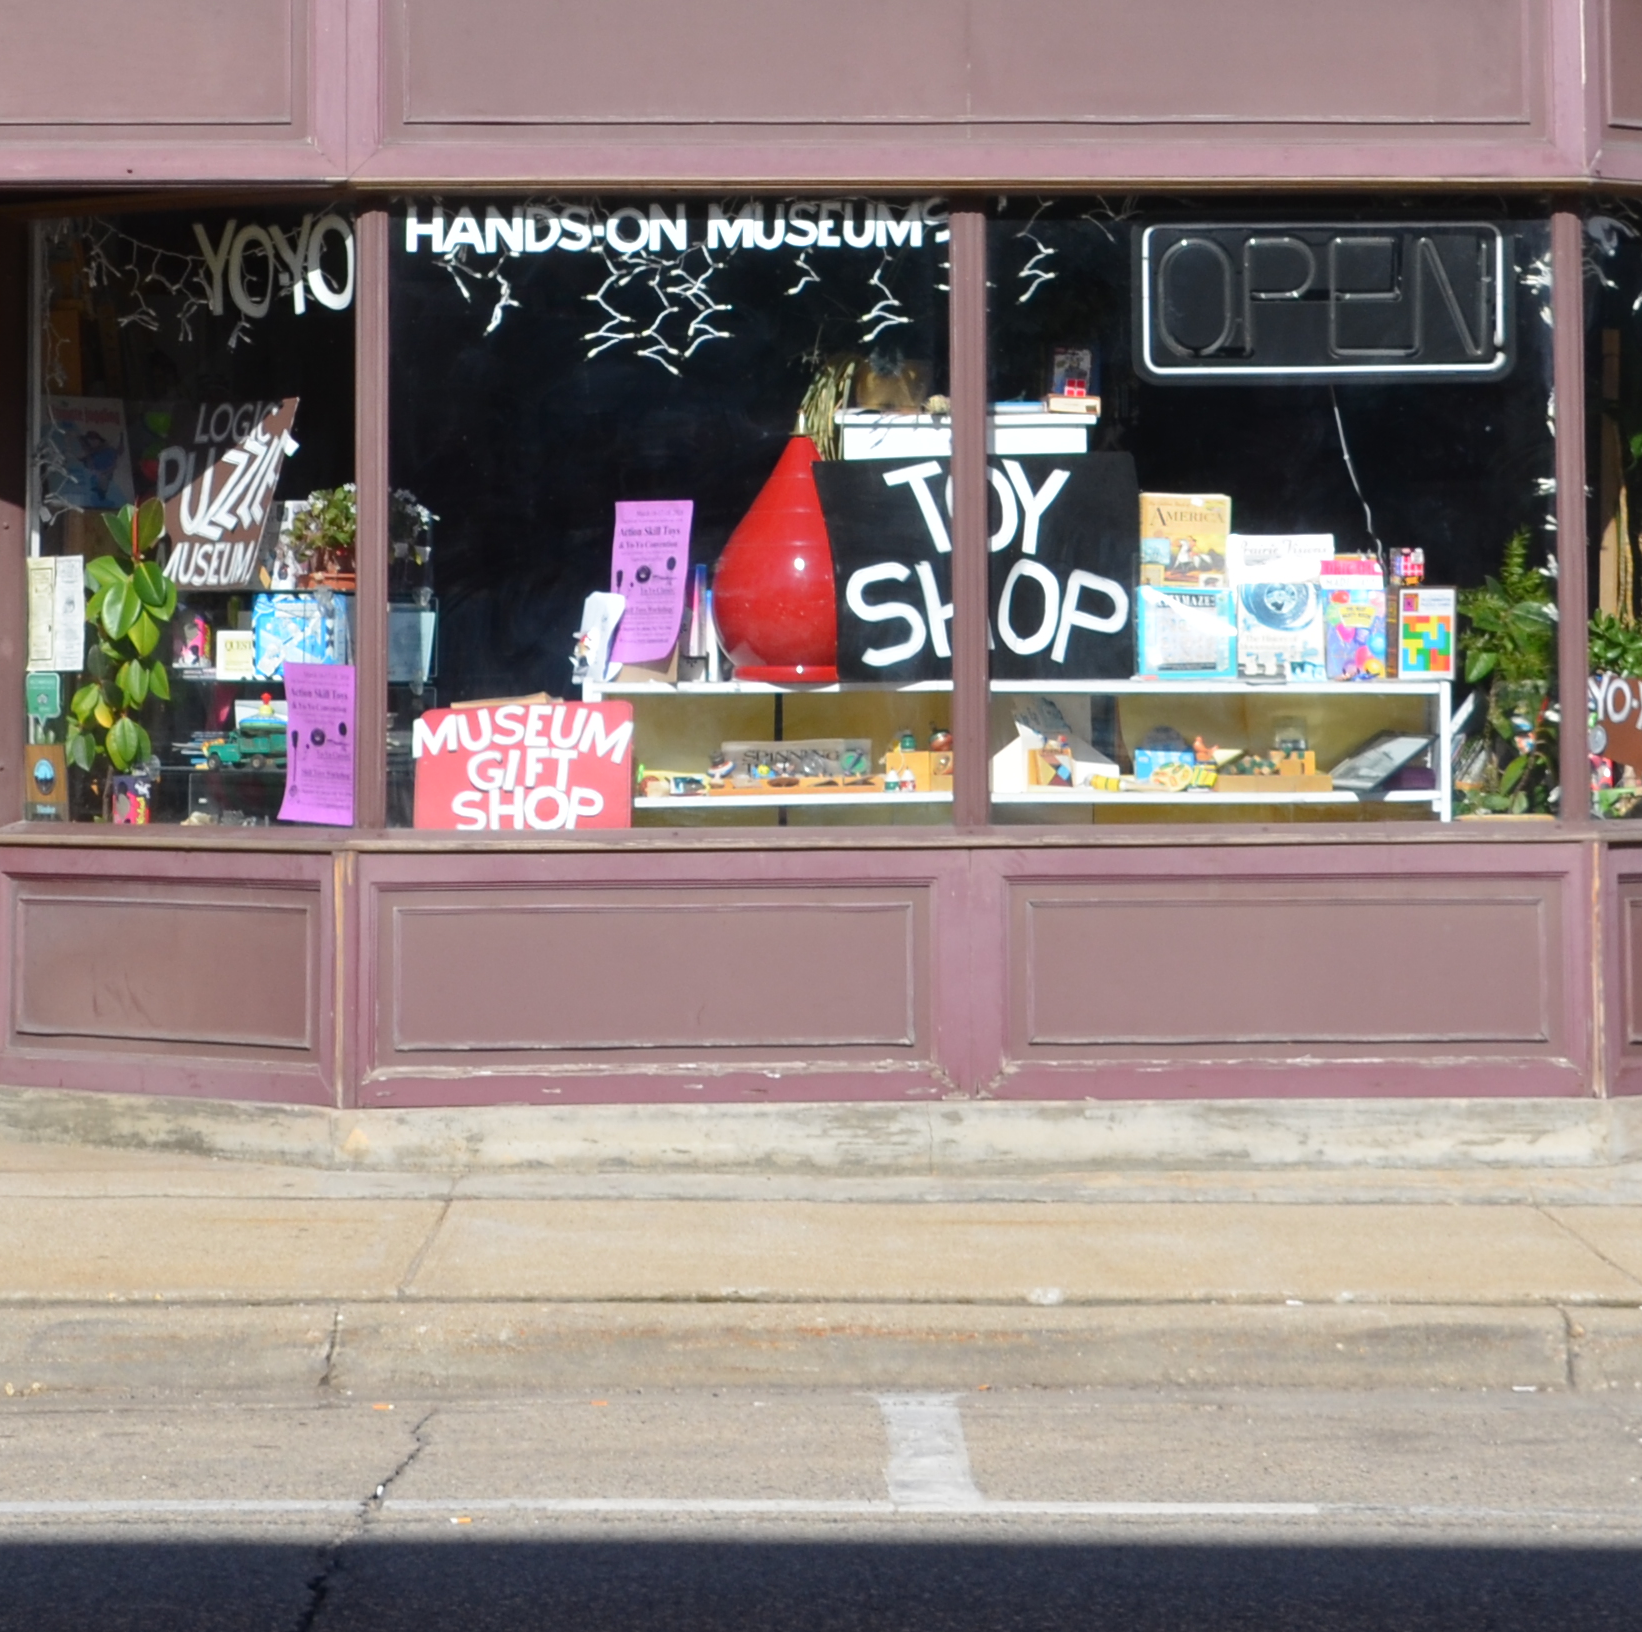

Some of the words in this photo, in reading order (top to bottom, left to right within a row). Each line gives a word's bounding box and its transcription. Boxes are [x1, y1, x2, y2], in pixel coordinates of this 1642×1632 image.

[406, 204, 688, 253] HANDS-ON
[1157, 236, 1488, 359] OPEN
[194, 401, 276, 446] LOGIC
[644, 526, 661, 536] Skill
[663, 525, 680, 538] Toys
[1150, 507, 1226, 527] AMERICA
[157, 541, 256, 587] MUSEUM
[412, 704, 634, 765] MUSEUM
[467, 747, 579, 792] GIFT
[451, 785, 604, 830] SHOP
